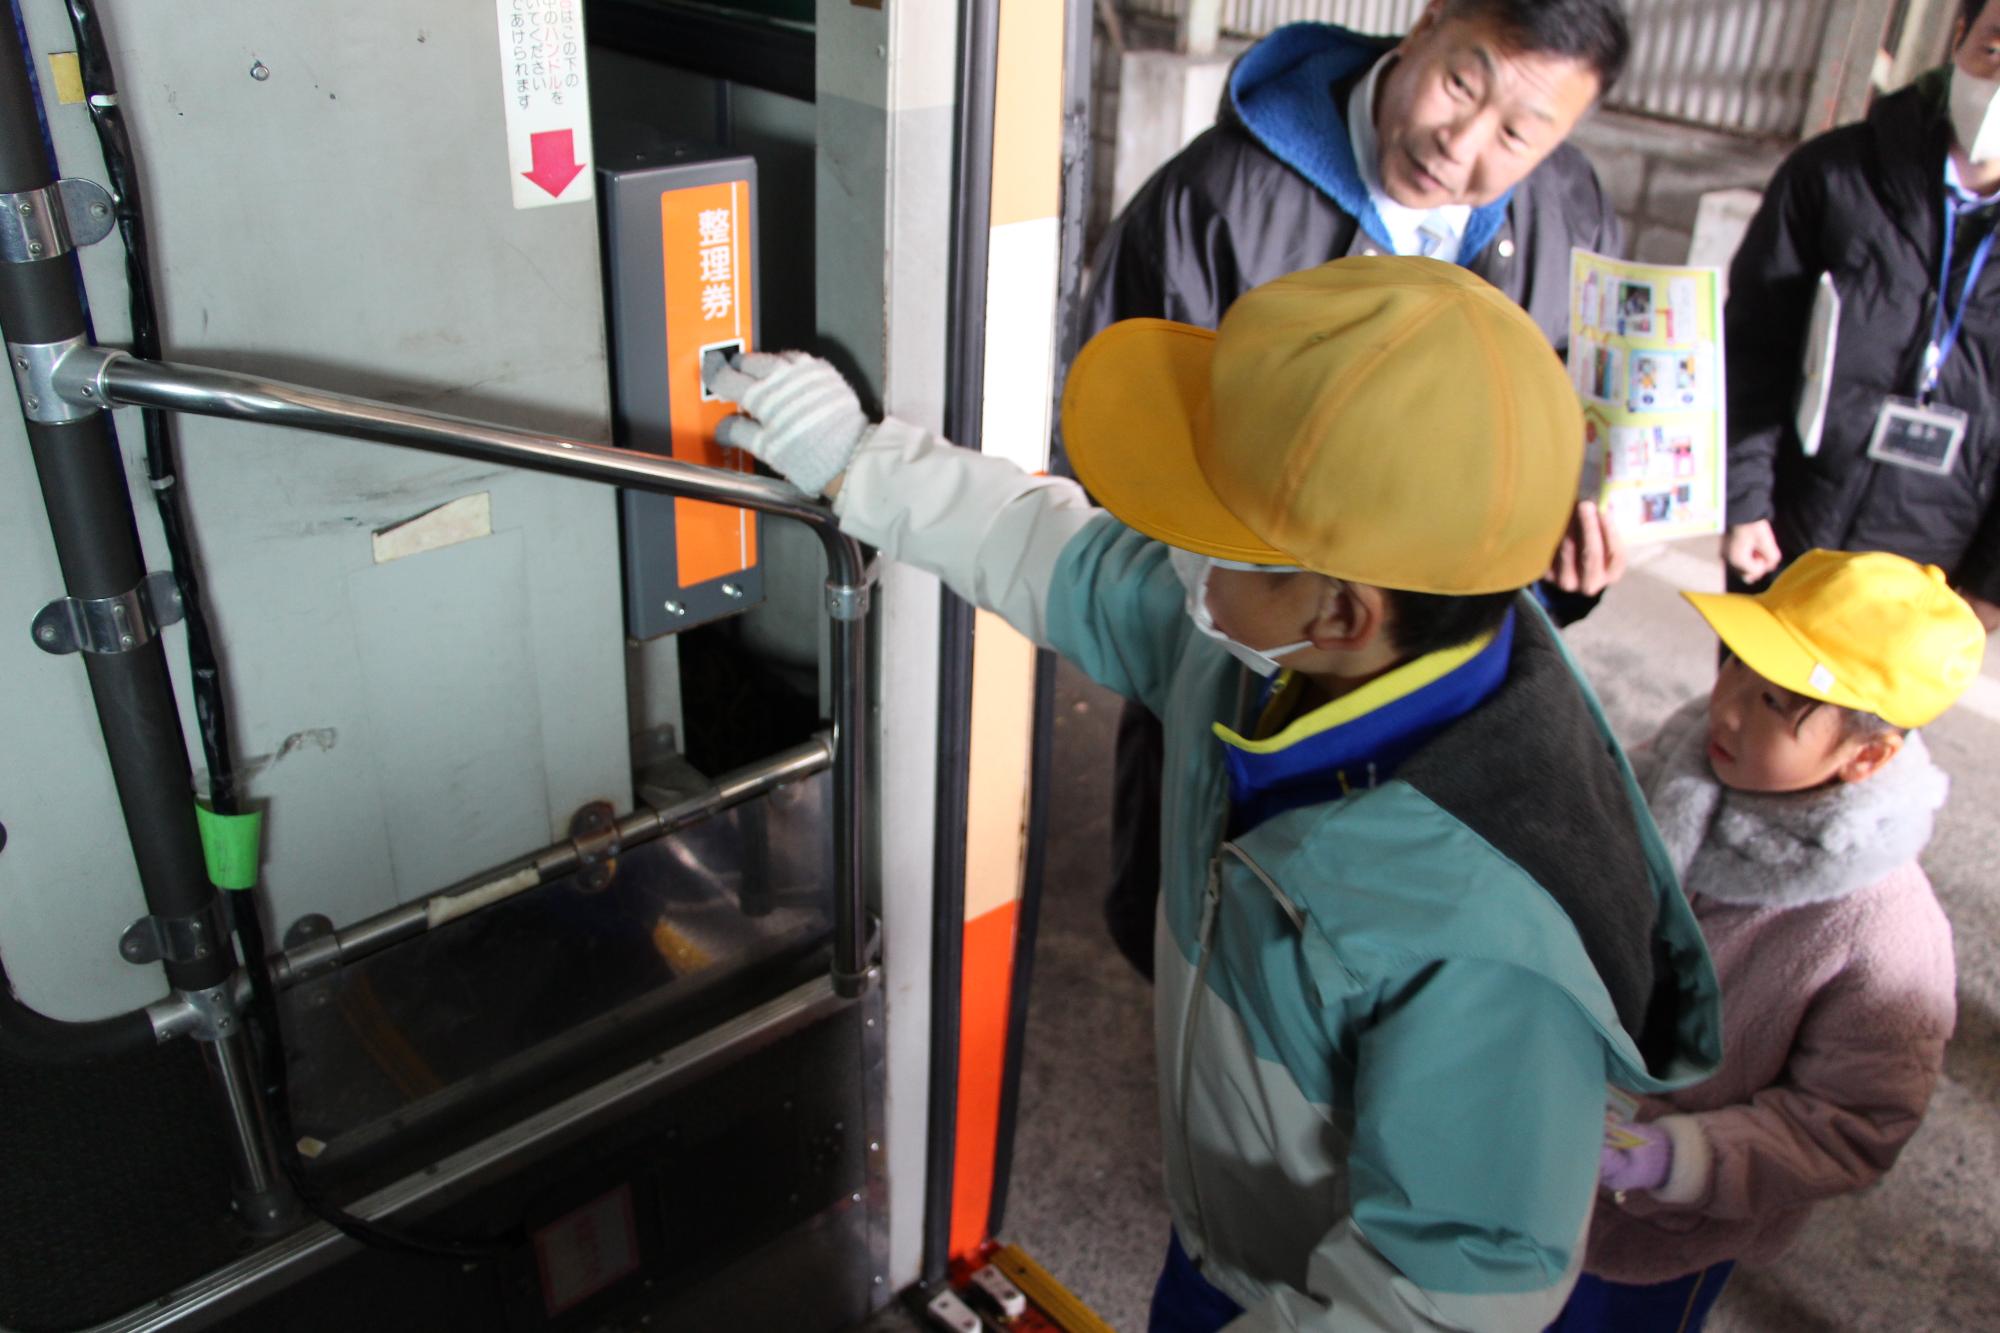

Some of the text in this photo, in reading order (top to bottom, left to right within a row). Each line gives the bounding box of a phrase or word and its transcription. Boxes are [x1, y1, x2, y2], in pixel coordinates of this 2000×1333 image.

[527, 0, 547, 91] いてください
[699, 207, 731, 320] 整理券
